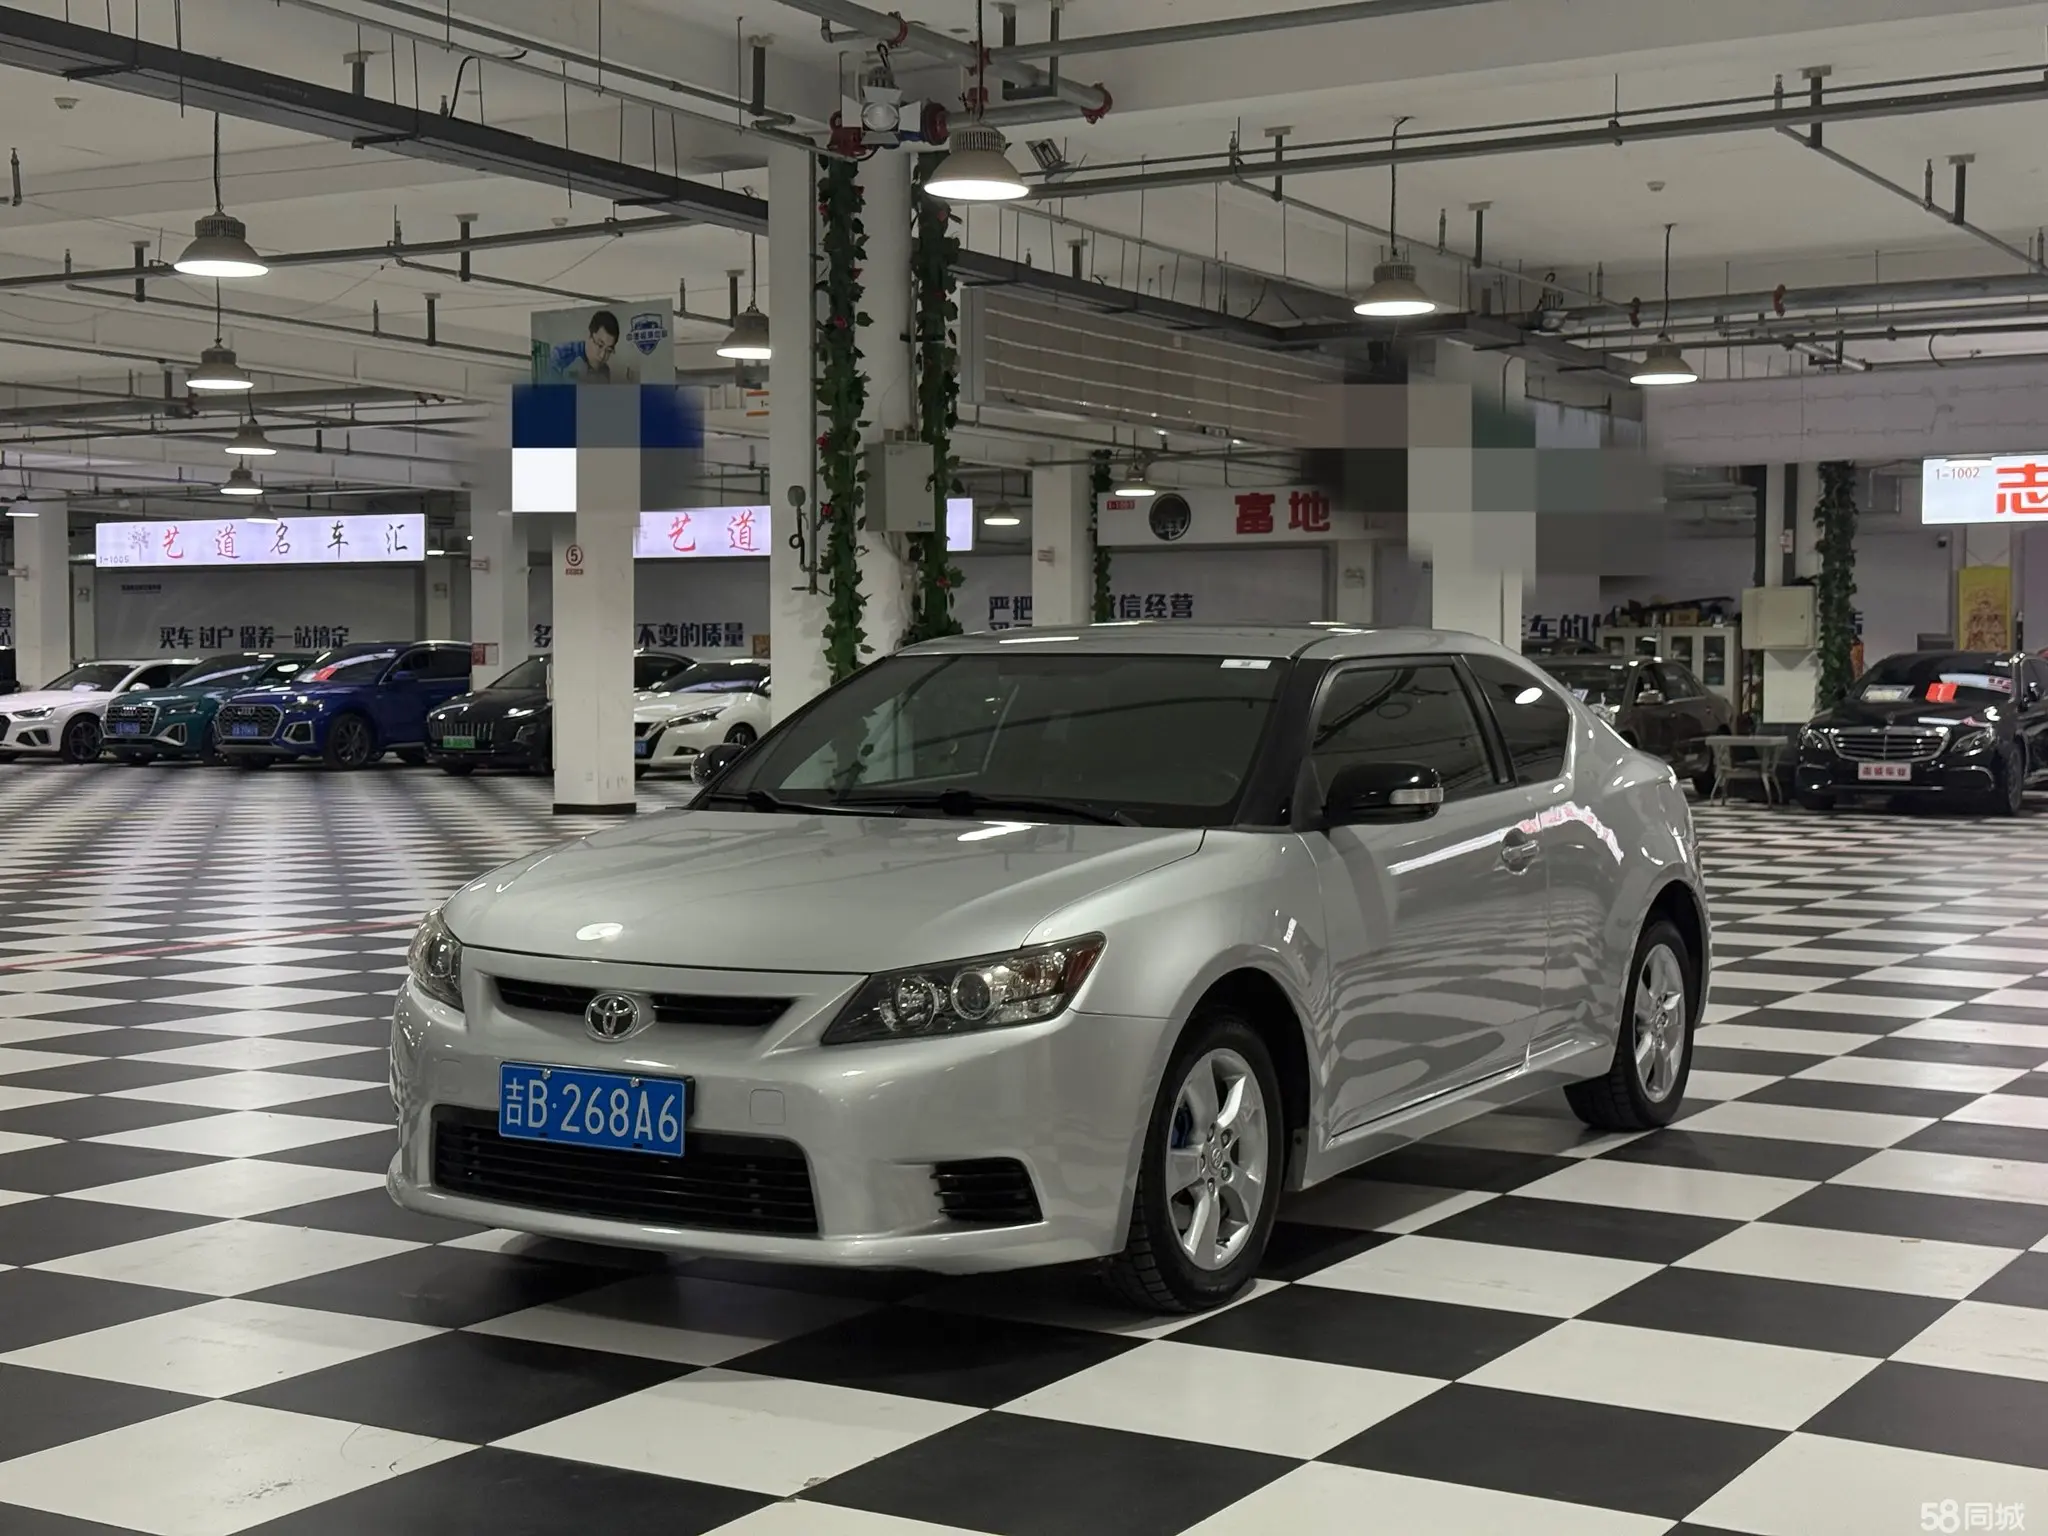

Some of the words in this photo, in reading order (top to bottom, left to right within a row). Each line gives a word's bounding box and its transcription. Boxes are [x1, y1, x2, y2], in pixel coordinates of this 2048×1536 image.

[1935, 466, 1981, 481] 1-1002
[1234, 490, 1331, 535] 富地
[667, 510, 761, 552] 艺道
[636, 622, 745, 649] 不变的质量
